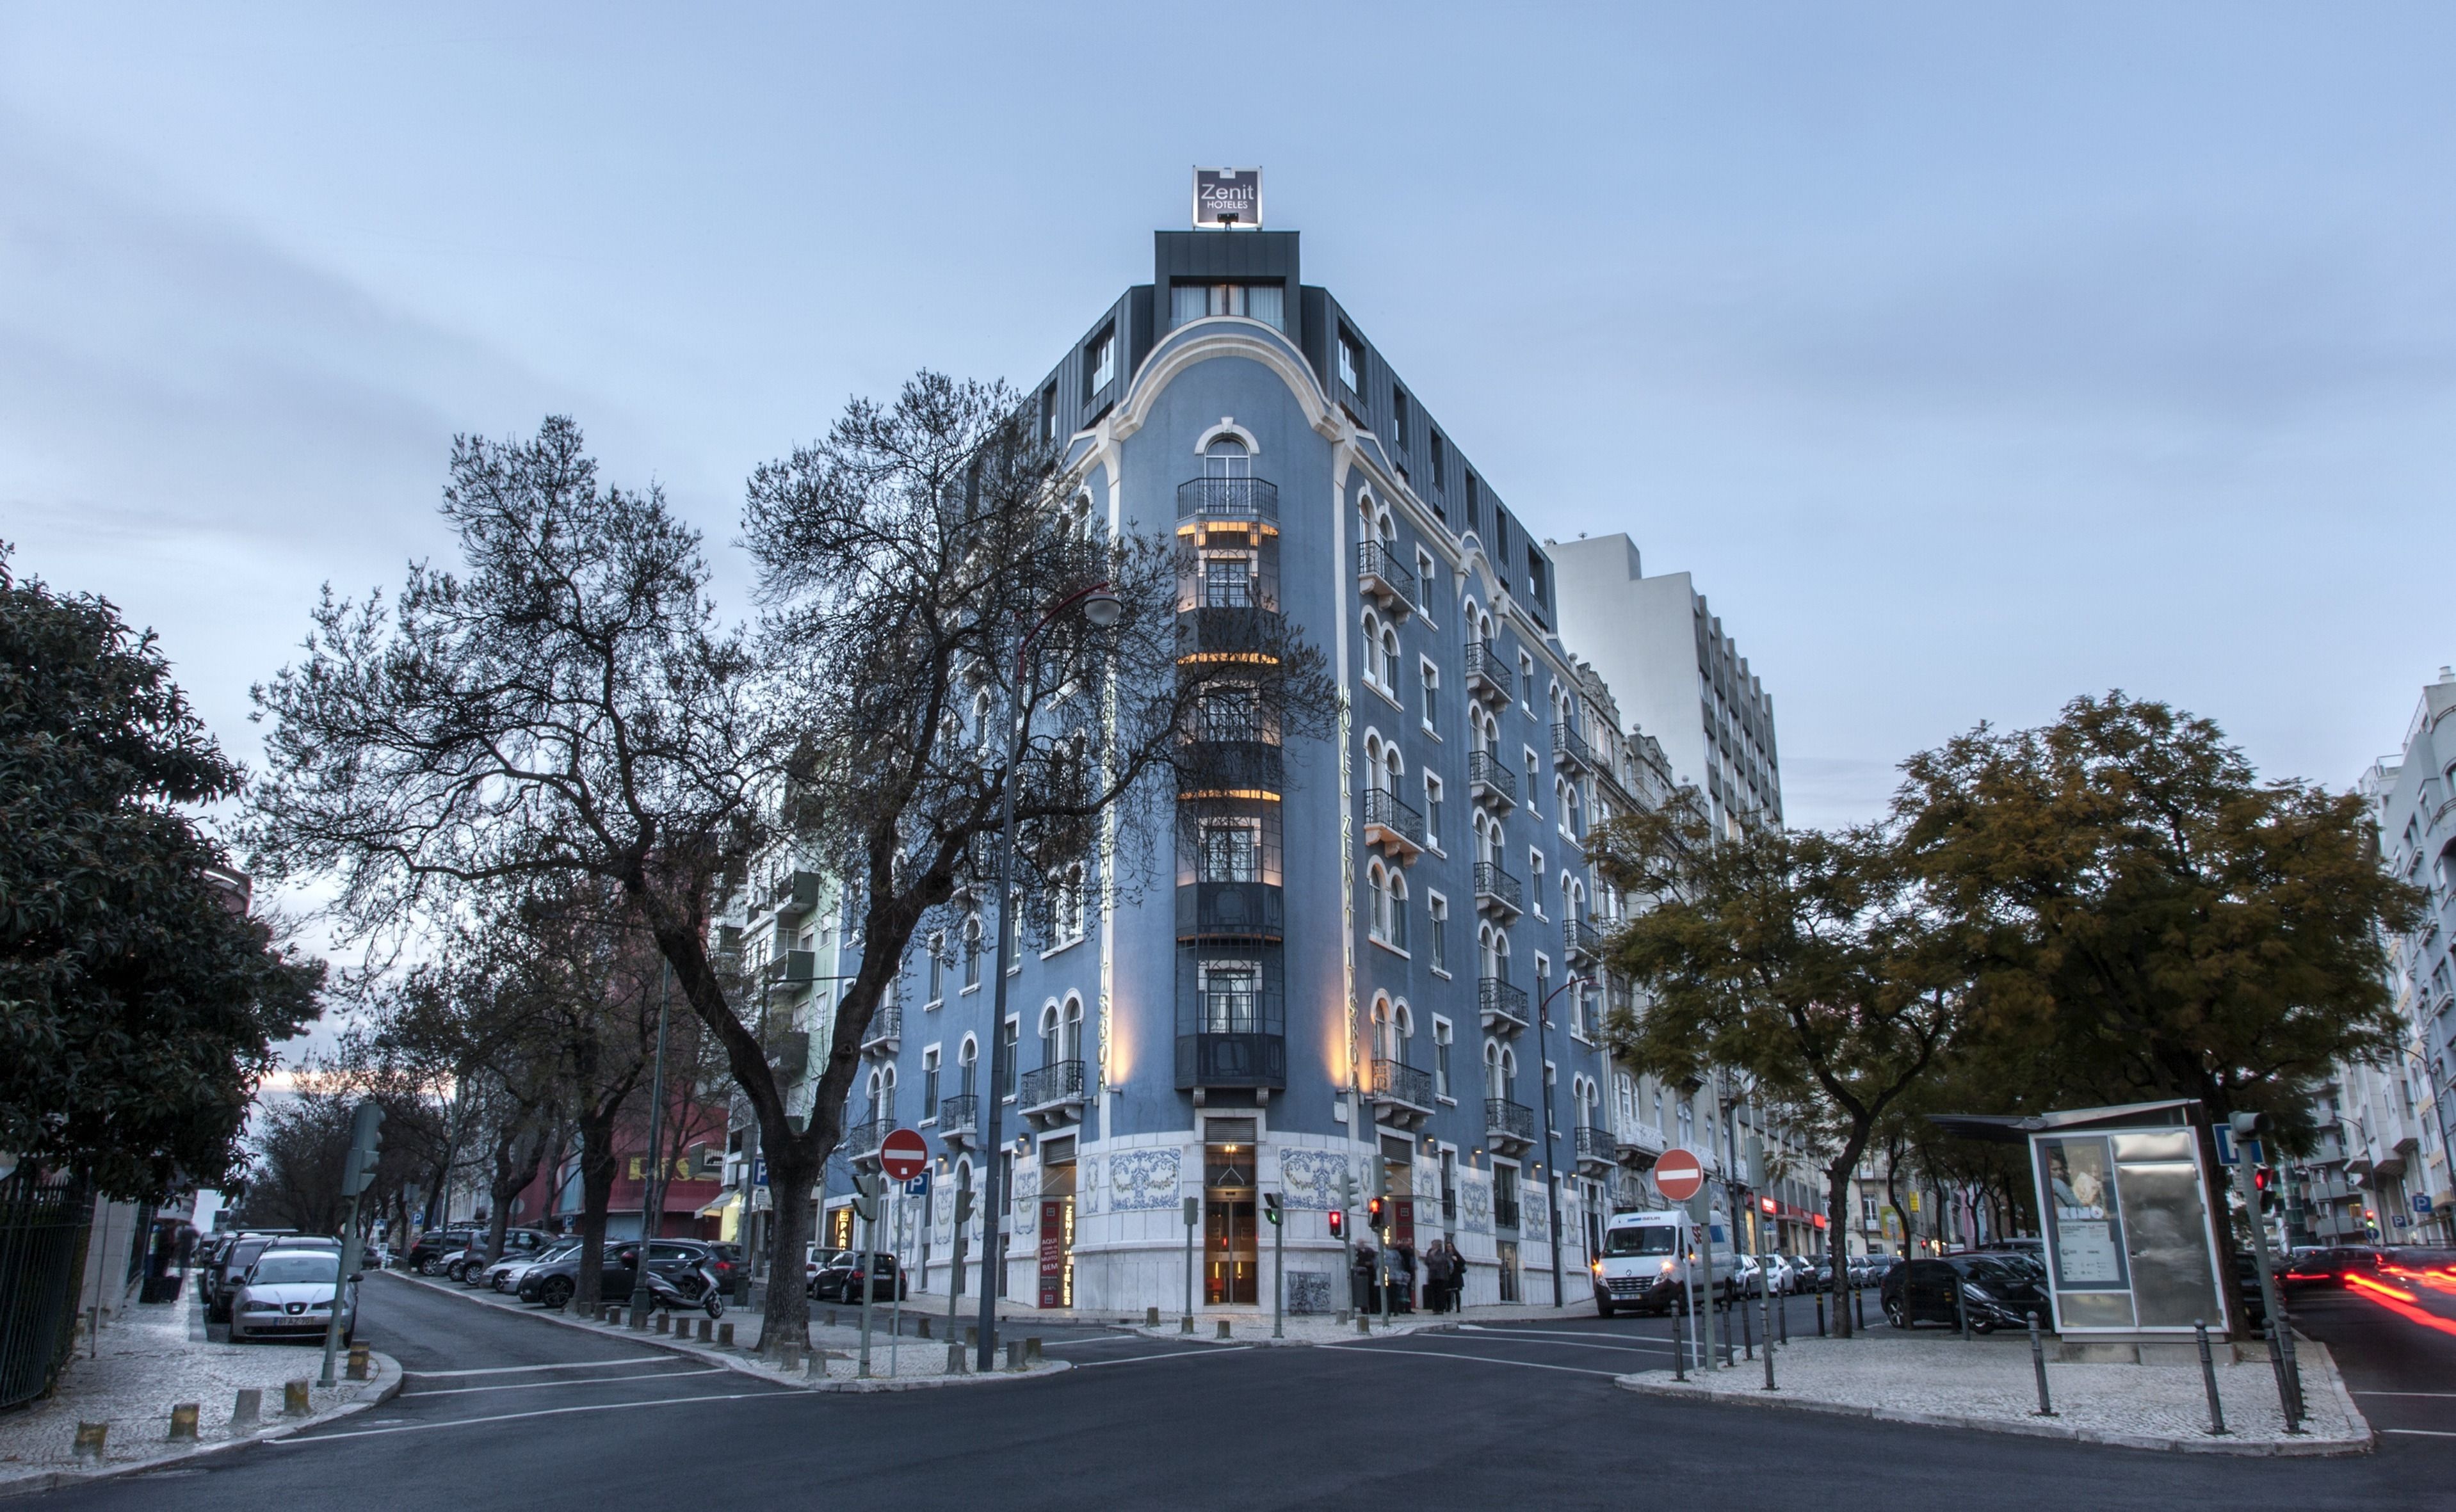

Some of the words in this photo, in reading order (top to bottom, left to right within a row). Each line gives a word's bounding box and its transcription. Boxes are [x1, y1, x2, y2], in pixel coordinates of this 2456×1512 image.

[1201, 184, 1254, 200] Zenit
[1207, 200, 1248, 209] HOTELES
[1339, 684, 1352, 798] HOTEL
[1342, 814, 1355, 928] ZENIT
[1097, 945, 1109, 1092] LISBOA
[1346, 947, 1359, 1094] LISBOA
[910, 1175, 923, 1192] P
[2416, 1198, 2428, 1210] P
[413, 1213, 421, 1223] P
[565, 1215, 573, 1226] P
[1064, 1205, 1073, 1245] ZENIT
[2394, 1216, 2403, 1226] P
